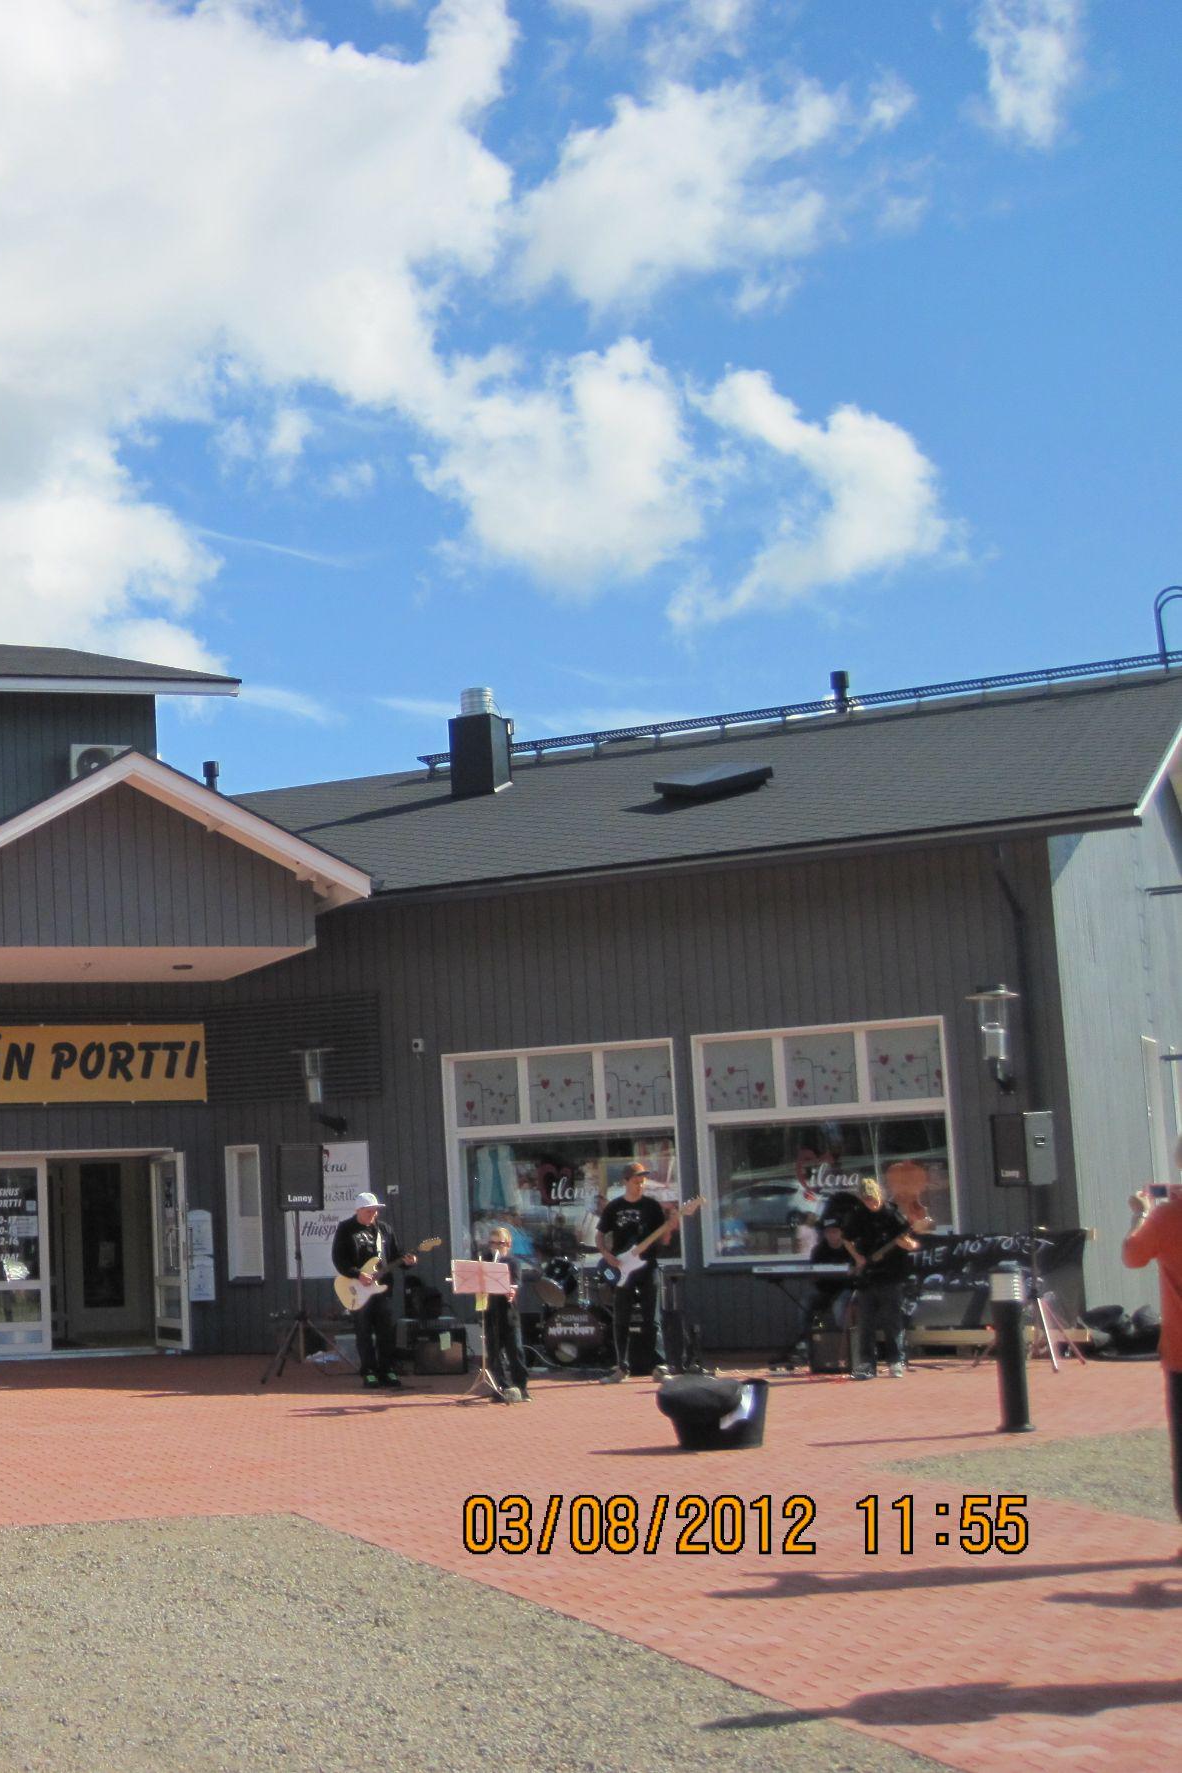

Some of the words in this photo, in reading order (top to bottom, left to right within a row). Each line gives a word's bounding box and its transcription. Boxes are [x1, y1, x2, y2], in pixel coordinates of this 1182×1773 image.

[51, 1040, 200, 1082] PORTTI
[287, 1194, 313, 1203] Laney
[908, 1246, 948, 1266] THE
